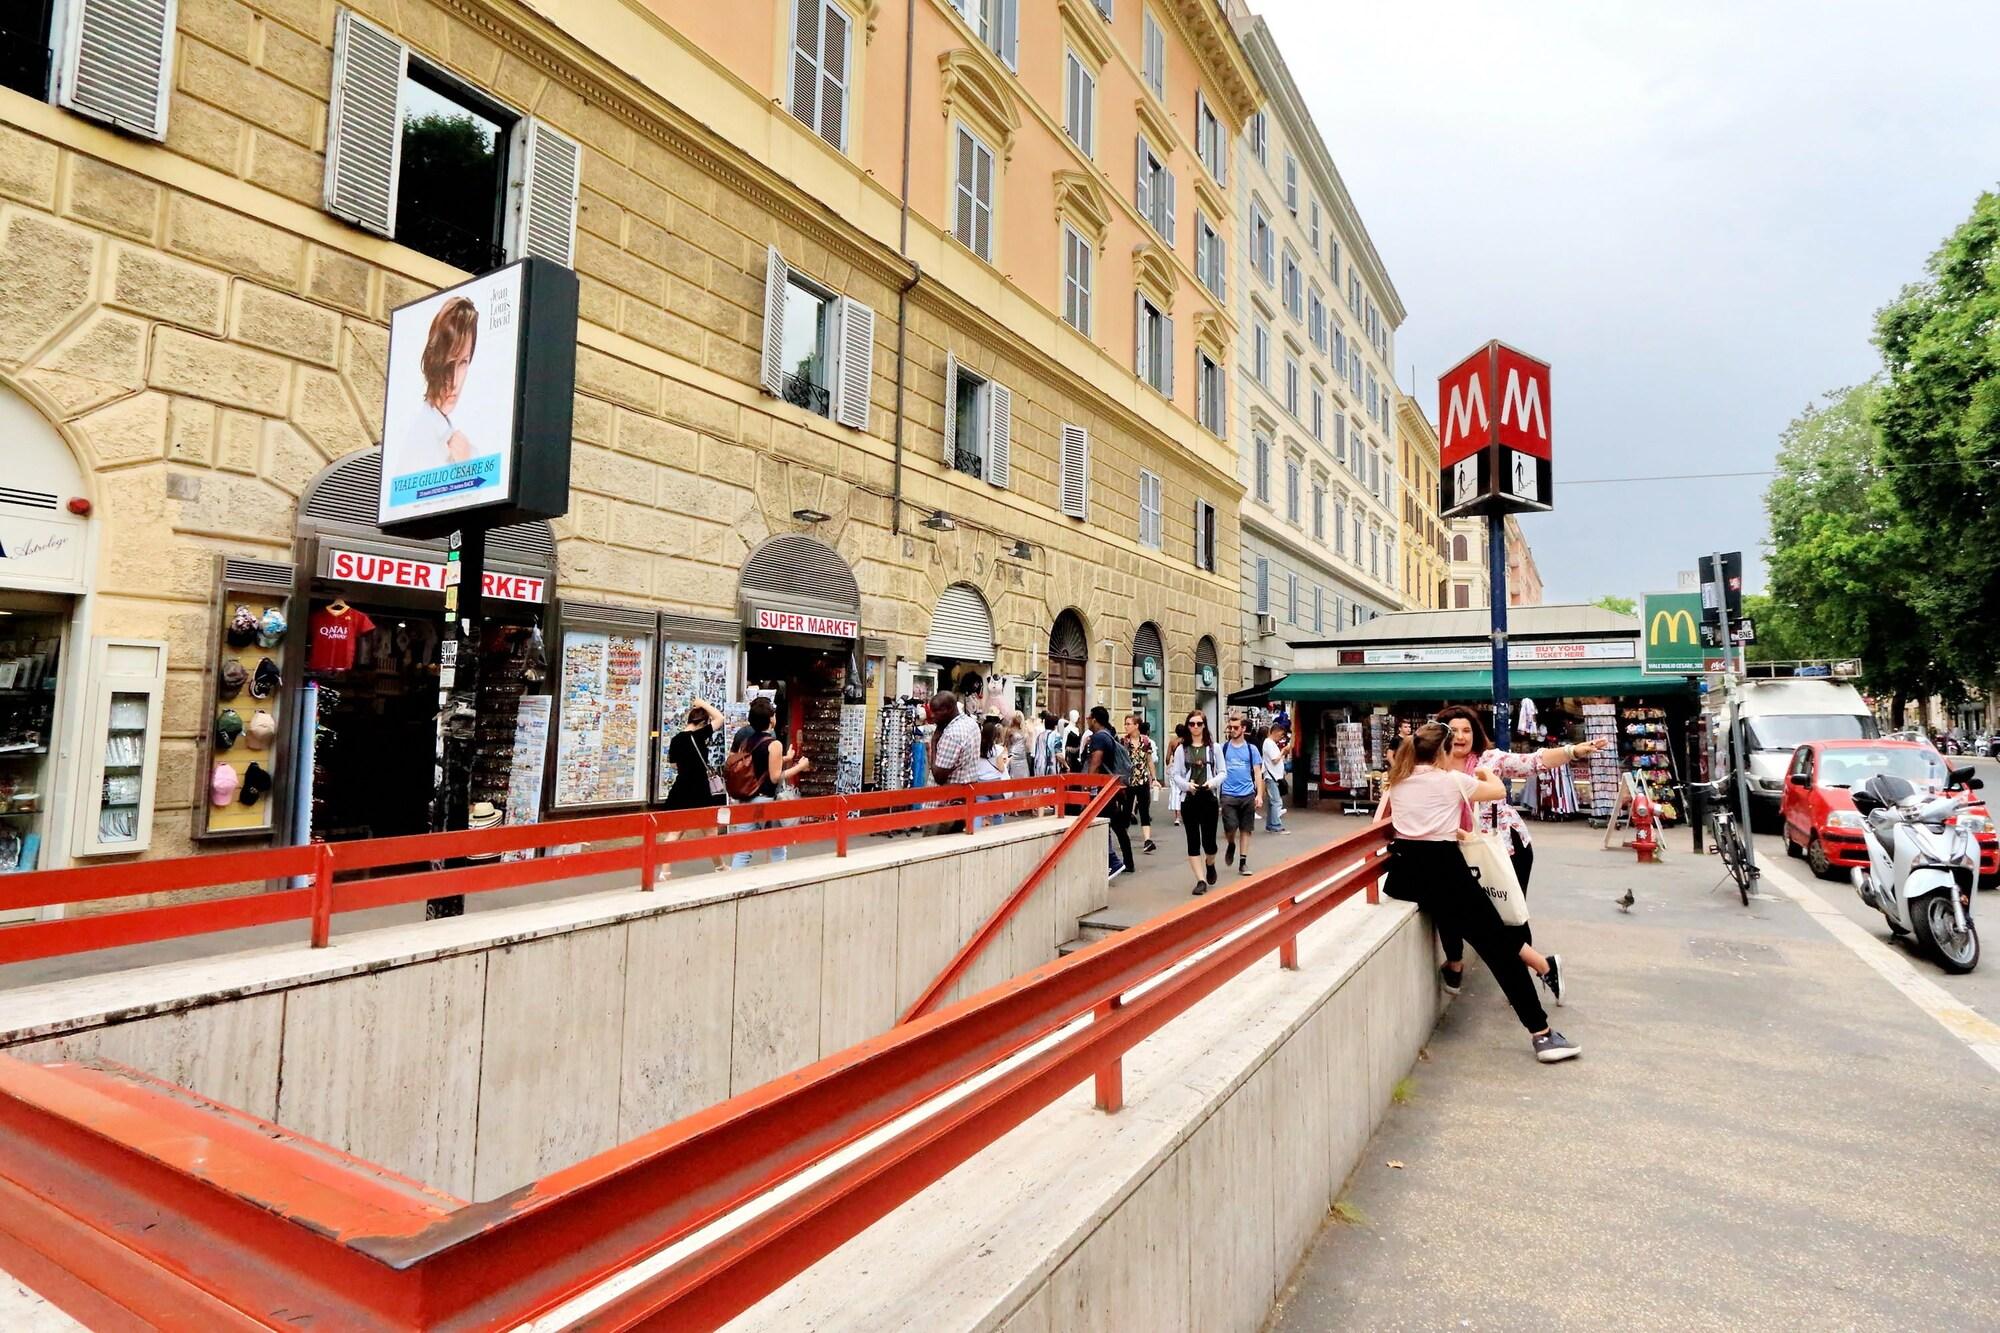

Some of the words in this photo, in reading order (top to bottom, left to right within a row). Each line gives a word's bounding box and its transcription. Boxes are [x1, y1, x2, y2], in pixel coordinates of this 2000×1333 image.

[1444, 372, 1490, 449] M
[1501, 368, 1547, 440] M
[394, 478, 418, 492] VIALE
[419, 470, 449, 488] GIULIO
[450, 461, 484, 481] CESARE
[484, 459, 496, 473] 86
[335, 553, 431, 588] SUPER
[760, 611, 804, 631] SUPER
[807, 617, 857, 637] MARKET
